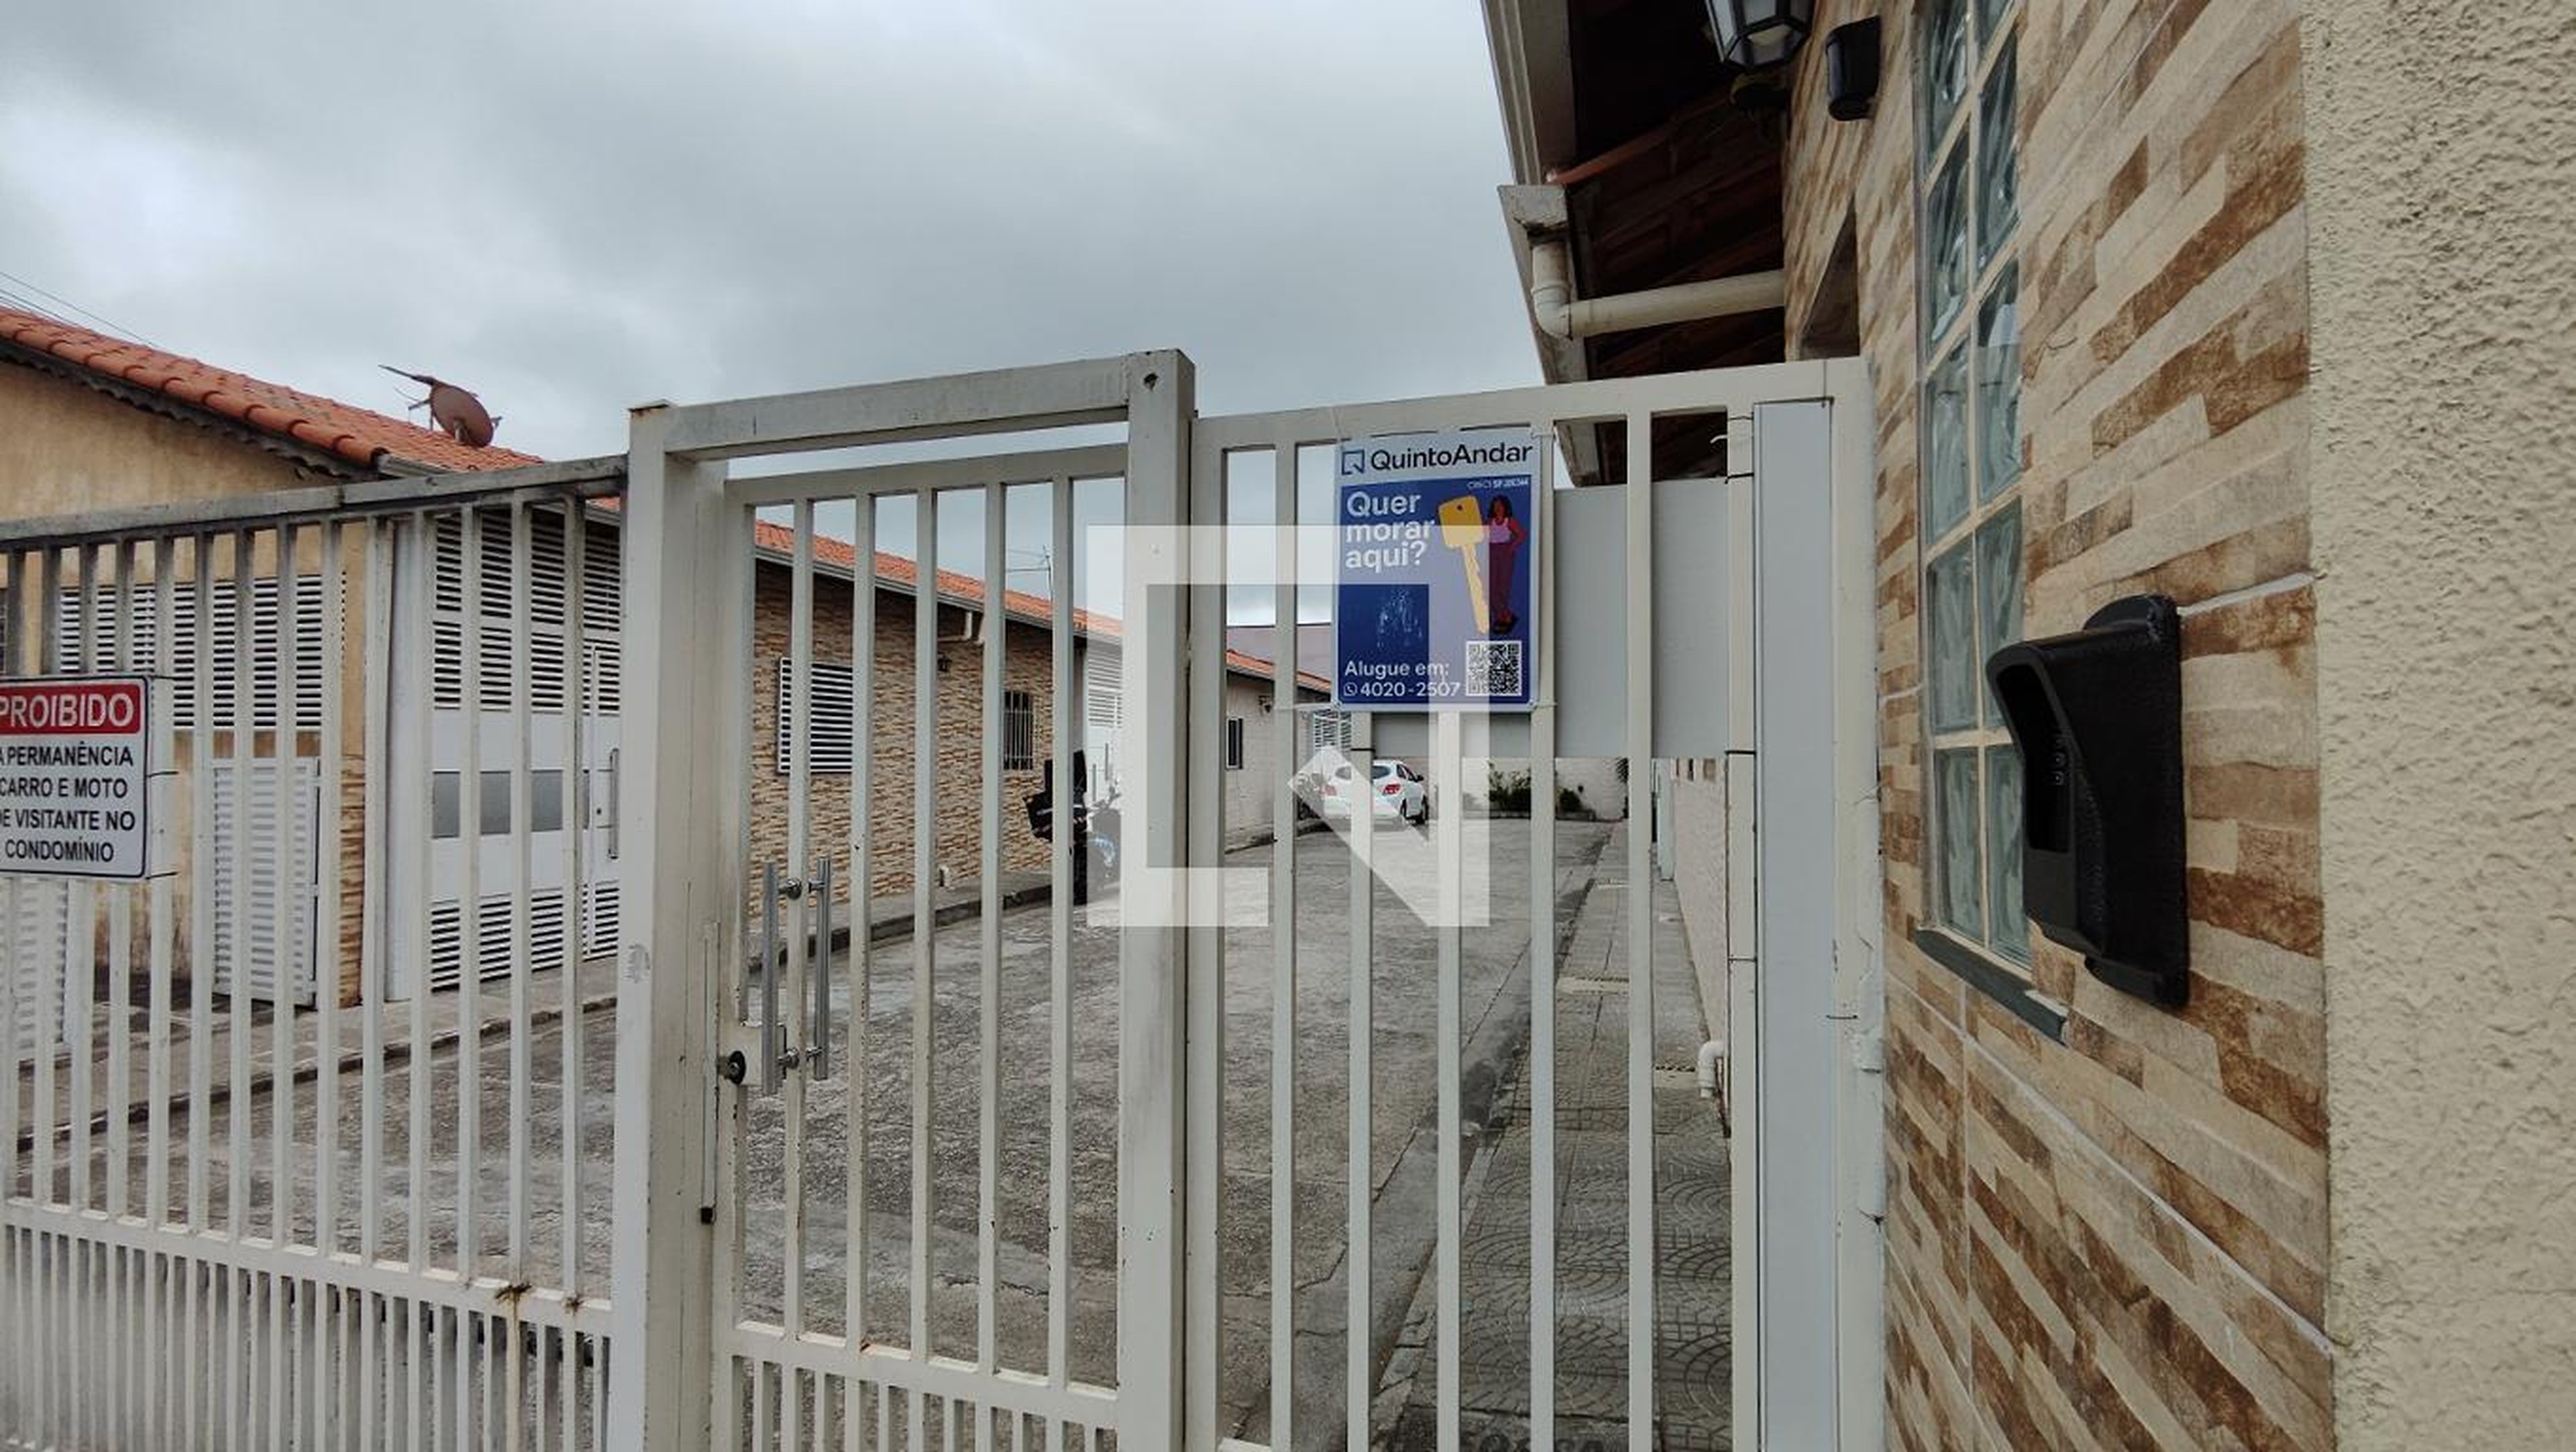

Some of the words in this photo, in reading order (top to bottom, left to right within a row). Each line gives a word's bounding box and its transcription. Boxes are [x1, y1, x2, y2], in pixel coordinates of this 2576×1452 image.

[1371, 442, 1534, 472] QuintoAndar
[1347, 491, 1421, 517] Quer
[1346, 519, 1436, 543] morar
[1345, 539, 1427, 574] aqui?
[1344, 660, 1411, 680] Alugue
[1415, 662, 1450, 676] em:
[7, 741, 134, 766] PERMANÊNCIA
[0, 777, 52, 797] CARRO
[58, 778, 68, 797] E
[74, 778, 127, 798] MOTO
[15, 809, 99, 831] VISITANTE
[106, 811, 136, 831] NO
[5, 836, 115, 863] CONDOMÍNIO
